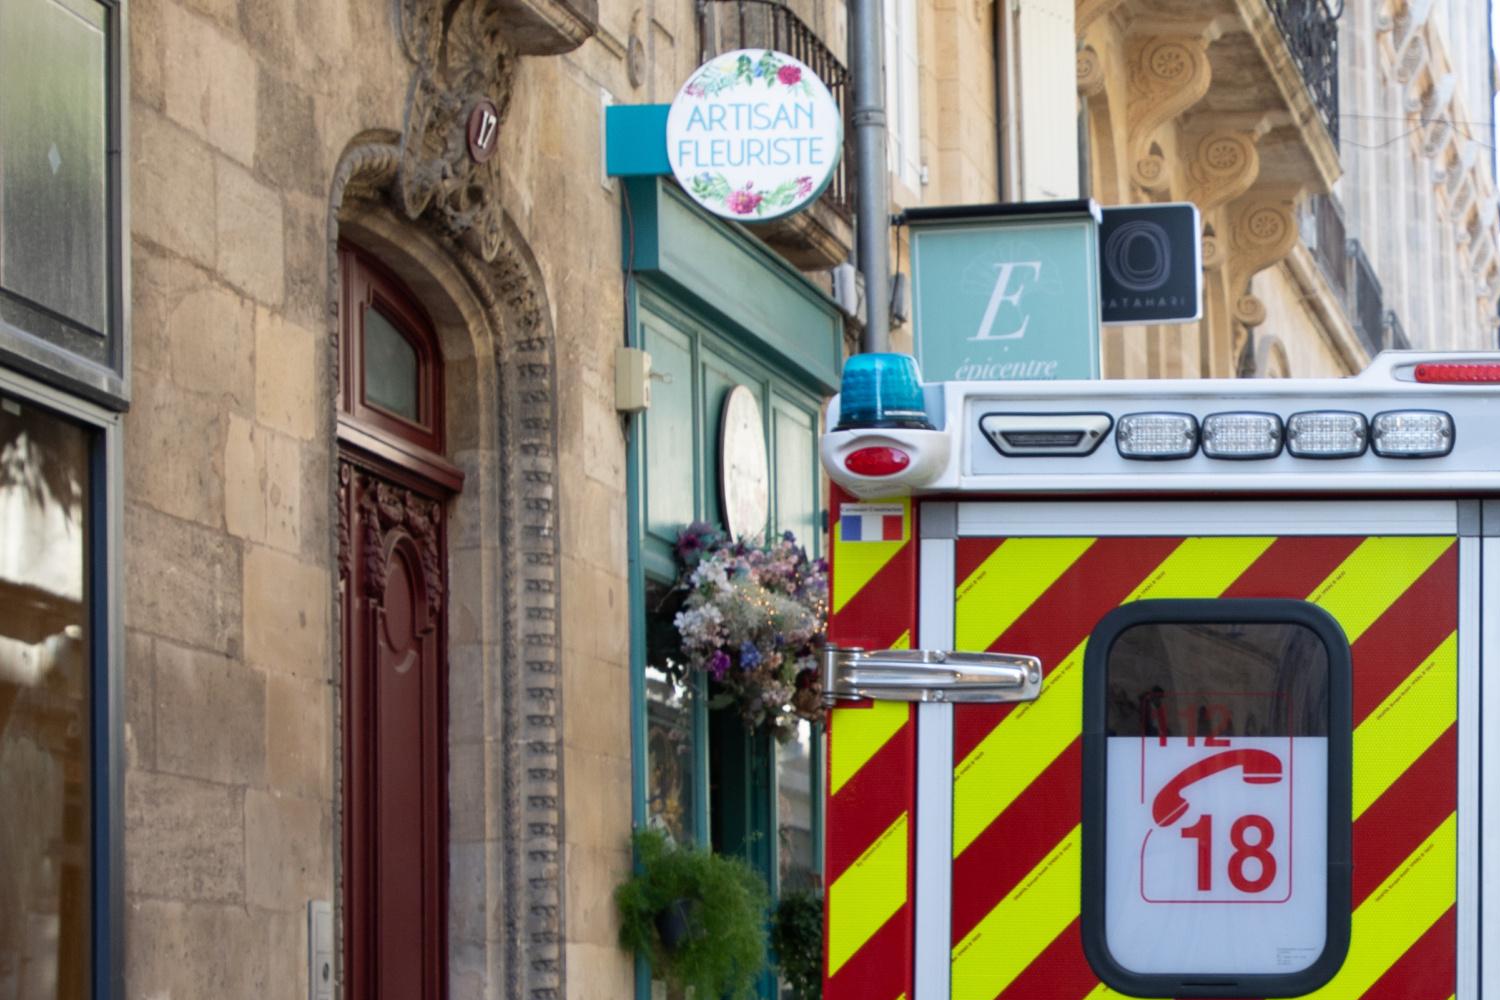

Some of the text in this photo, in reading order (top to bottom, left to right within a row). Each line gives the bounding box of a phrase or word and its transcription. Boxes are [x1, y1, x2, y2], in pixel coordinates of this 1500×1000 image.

[477, 110, 497, 149] 17
[686, 102, 815, 132] ARTISAN
[678, 136, 824, 167] FLEURISTE
[966, 261, 1042, 341] E
[1102, 296, 1186, 309] ATAHARI
[954, 357, 1058, 381] épicentre
[1151, 703, 1232, 747] 112
[1181, 814, 1277, 893] 18
